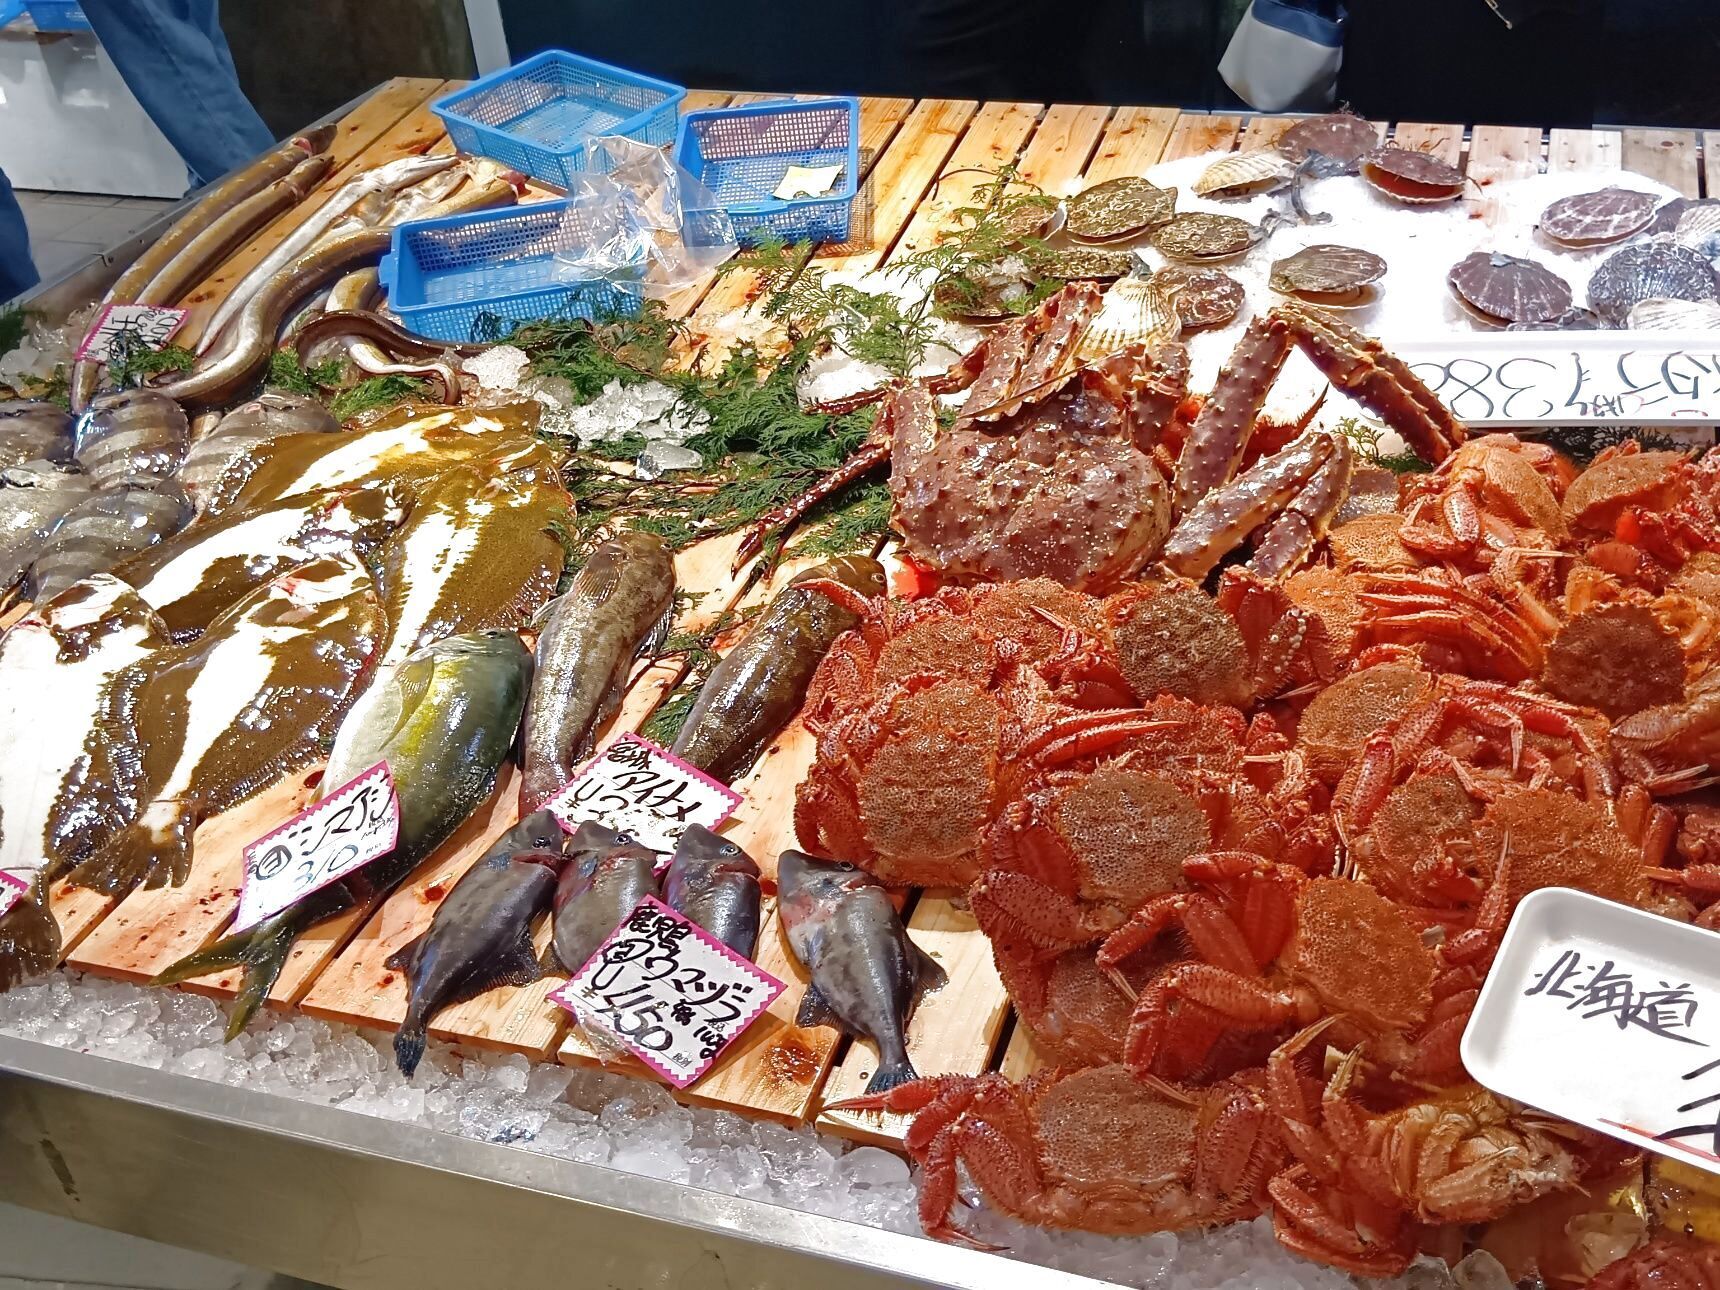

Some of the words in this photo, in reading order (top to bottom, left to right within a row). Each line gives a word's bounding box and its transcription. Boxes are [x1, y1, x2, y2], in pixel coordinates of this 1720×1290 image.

[613, 770, 703, 823] アイナメ
[1523, 949, 1711, 1048] 北海道
